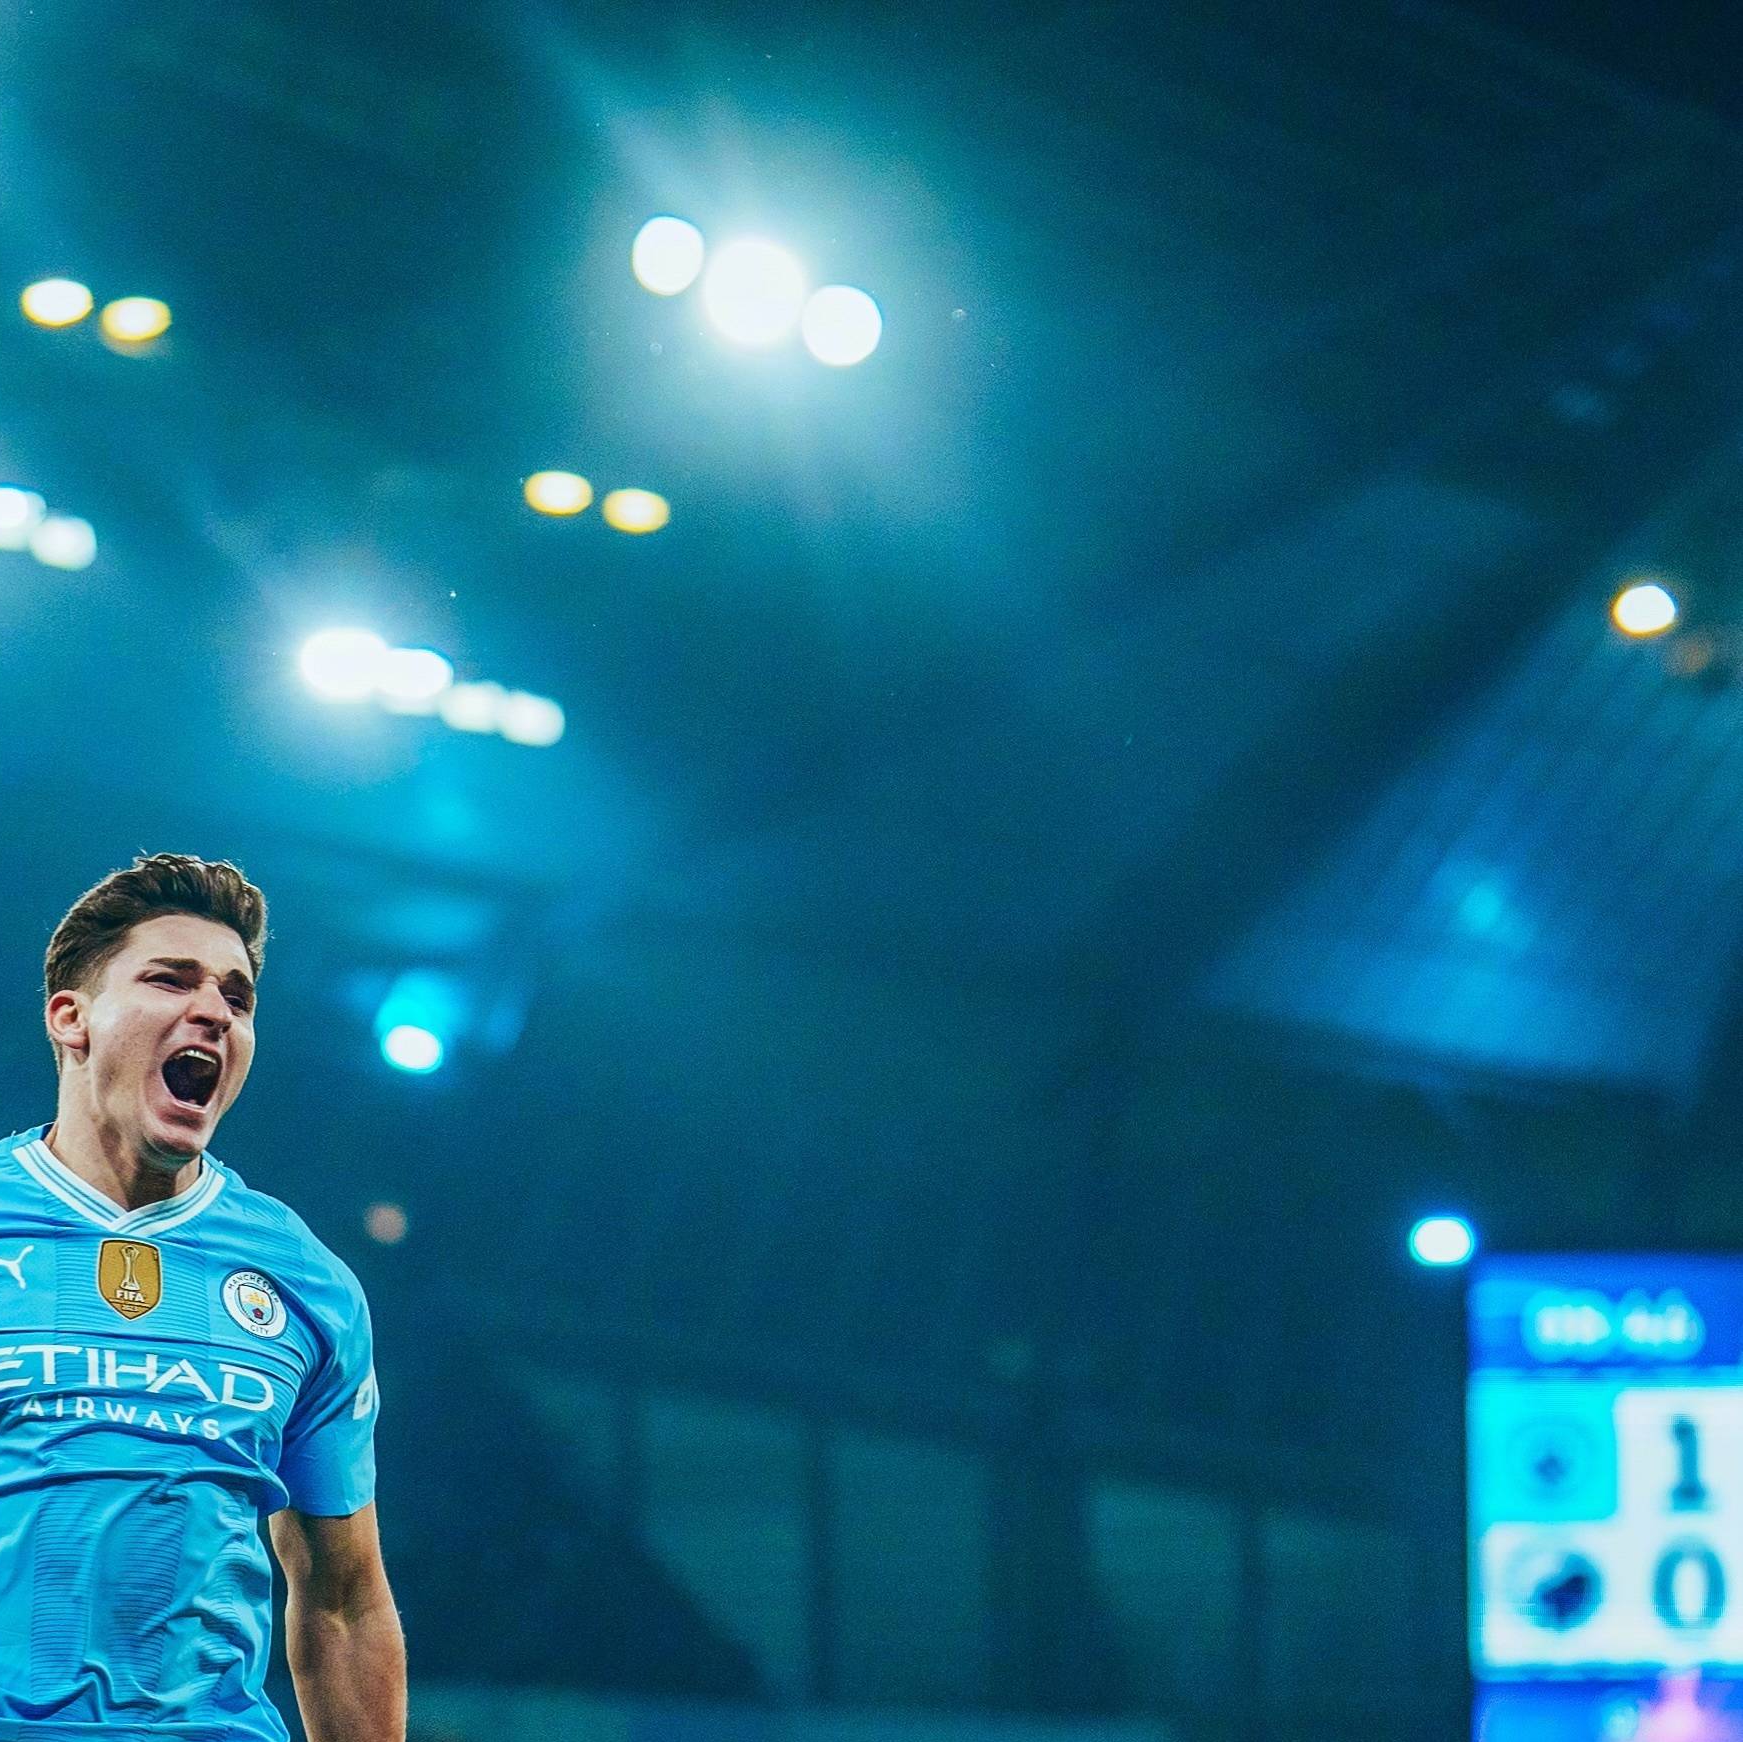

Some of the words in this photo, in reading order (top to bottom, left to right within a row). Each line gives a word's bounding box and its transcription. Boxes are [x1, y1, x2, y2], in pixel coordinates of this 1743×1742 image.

[115, 1289, 145, 1303] FIFA
[227, 1274, 279, 1303] MANCHESTER
[250, 1324, 270, 1335] CITY
[21, 1394, 222, 1441] AIRWAYS
[1667, 1412, 1712, 1515] 1
[1651, 1536, 1729, 1634] 0
